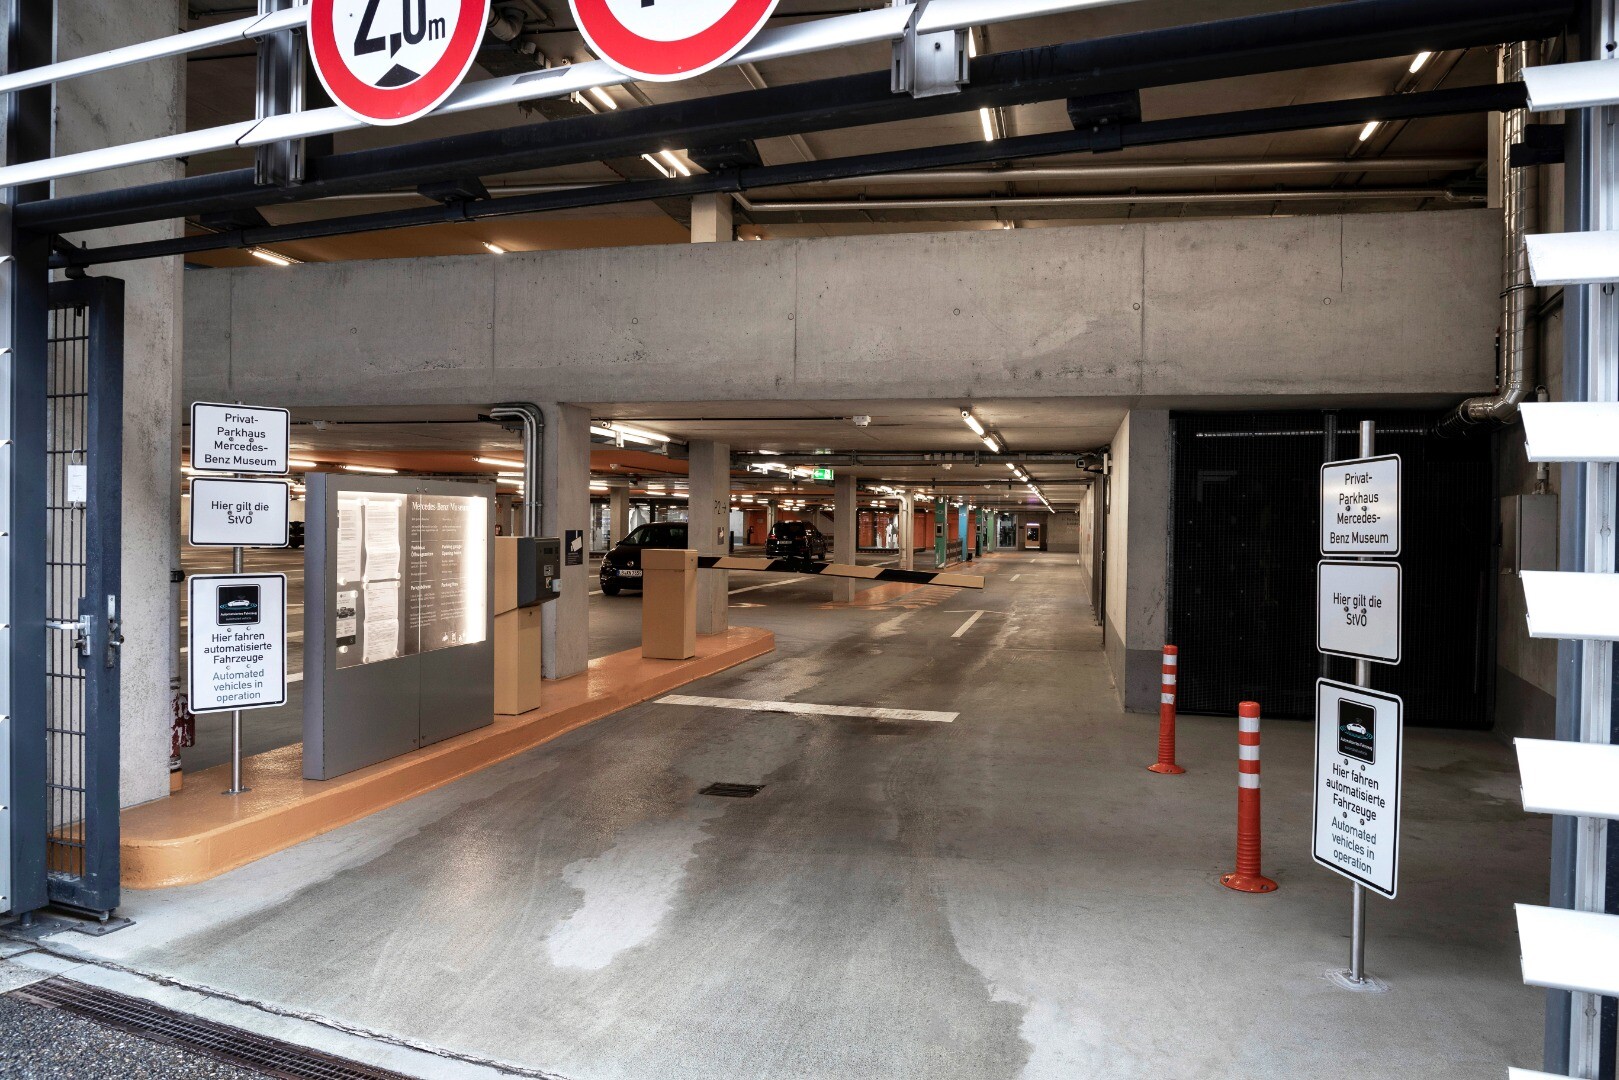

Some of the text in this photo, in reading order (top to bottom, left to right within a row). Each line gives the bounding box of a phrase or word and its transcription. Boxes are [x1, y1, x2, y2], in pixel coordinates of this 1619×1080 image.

[225, 413, 258, 424] Privat-
[217, 427, 266, 438] Parkhaus
[214, 441, 268, 452] Mercedes-
[204, 454, 277, 466] Benz Museum
[1345, 472, 1373, 485] Privat-
[1339, 492, 1379, 505] Parkhaus
[211, 501, 270, 512] Hier gilt die
[228, 516, 253, 524] StVO
[1337, 511, 1381, 524] Mercedes-
[1330, 532, 1389, 544] Benz Museum
[1333, 592, 1382, 609] Hier gilt die
[1346, 613, 1367, 627] StVO
[211, 632, 265, 642] Hier fahren
[203, 642, 272, 654] automatisierte
[213, 654, 264, 664] Fahrzeuge
[212, 669, 265, 681] Automated
[213, 680, 263, 691] vehicles in
[216, 692, 261, 703] operation
[1332, 763, 1379, 790] Hier fahren
[1326, 778, 1386, 808] automatisierte
[1333, 793, 1377, 821] Fahrzeuge
[1331, 816, 1377, 845] Automated
[1331, 833, 1375, 860] vehicles in
[1333, 849, 1372, 874] operation
